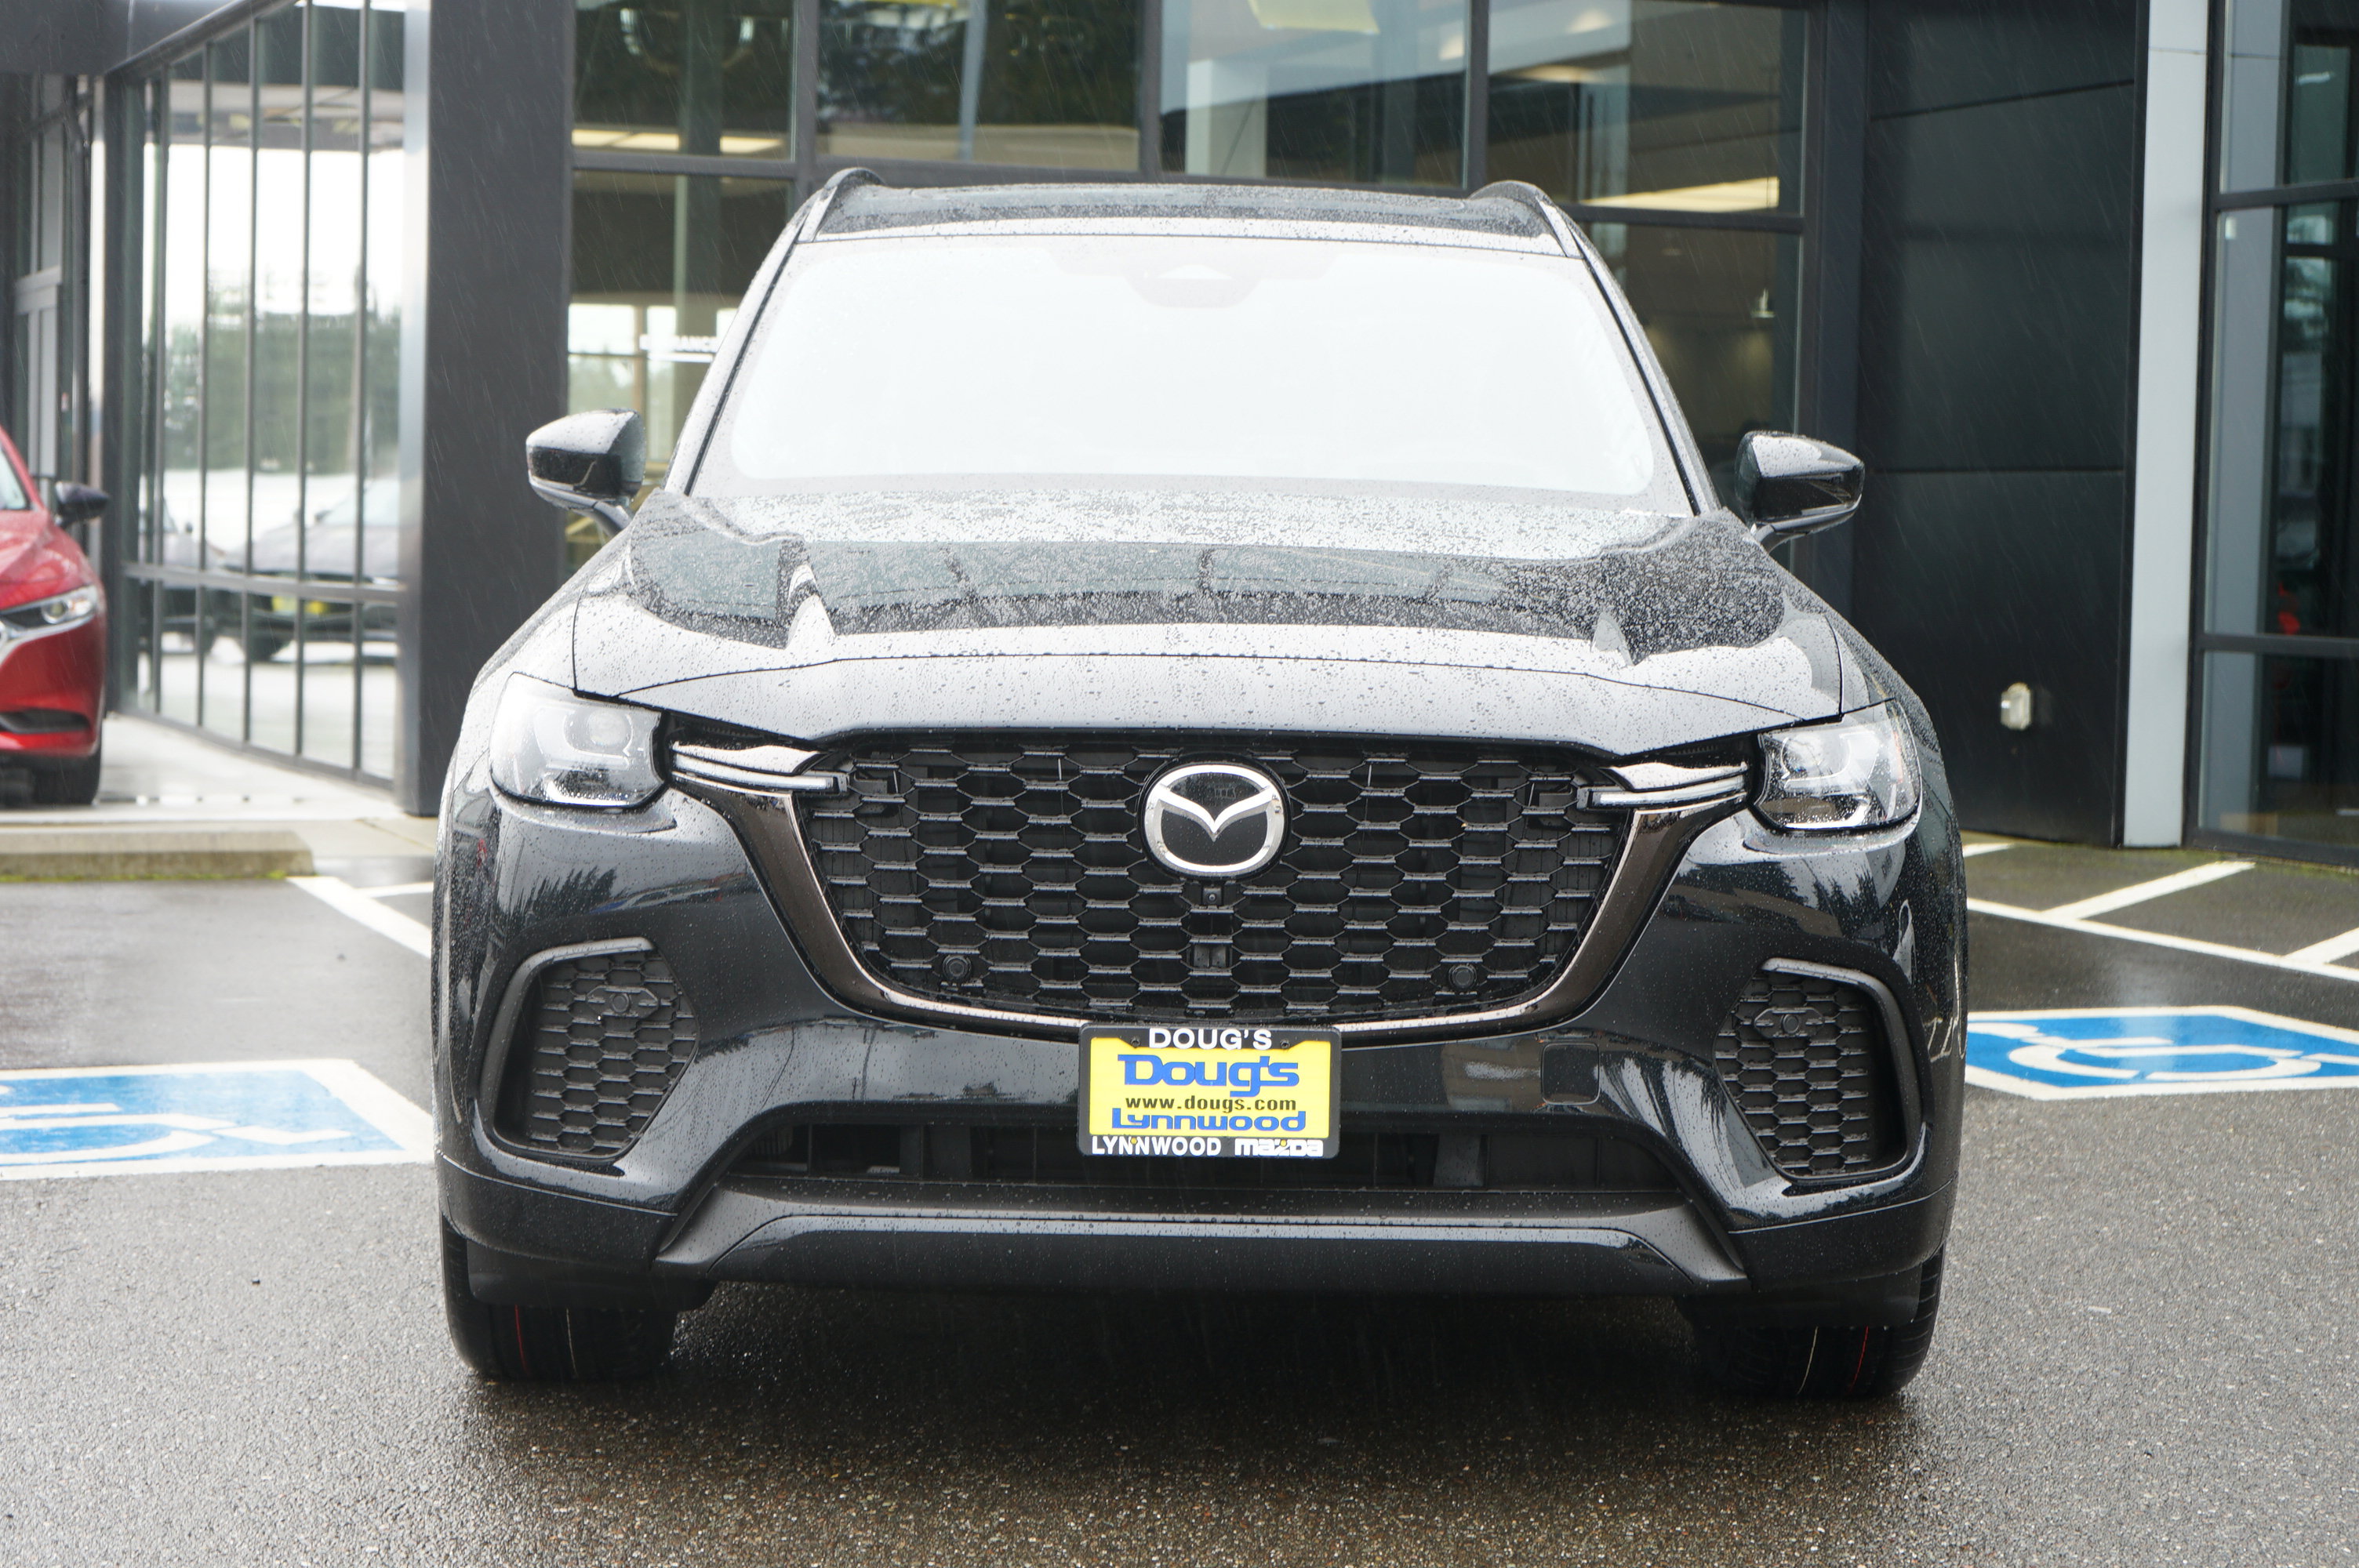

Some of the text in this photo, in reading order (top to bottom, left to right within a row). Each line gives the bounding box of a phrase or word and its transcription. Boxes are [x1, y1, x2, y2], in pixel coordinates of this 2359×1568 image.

[1148, 1028, 1272, 1050] DOUG'S
[1118, 1054, 1299, 1097] Doug's
[1125, 1095, 1296, 1112] www.dougs.com
[1112, 1108, 1306, 1131] Lynnwood
[1092, 1136, 1221, 1156] LYNNWOOD
